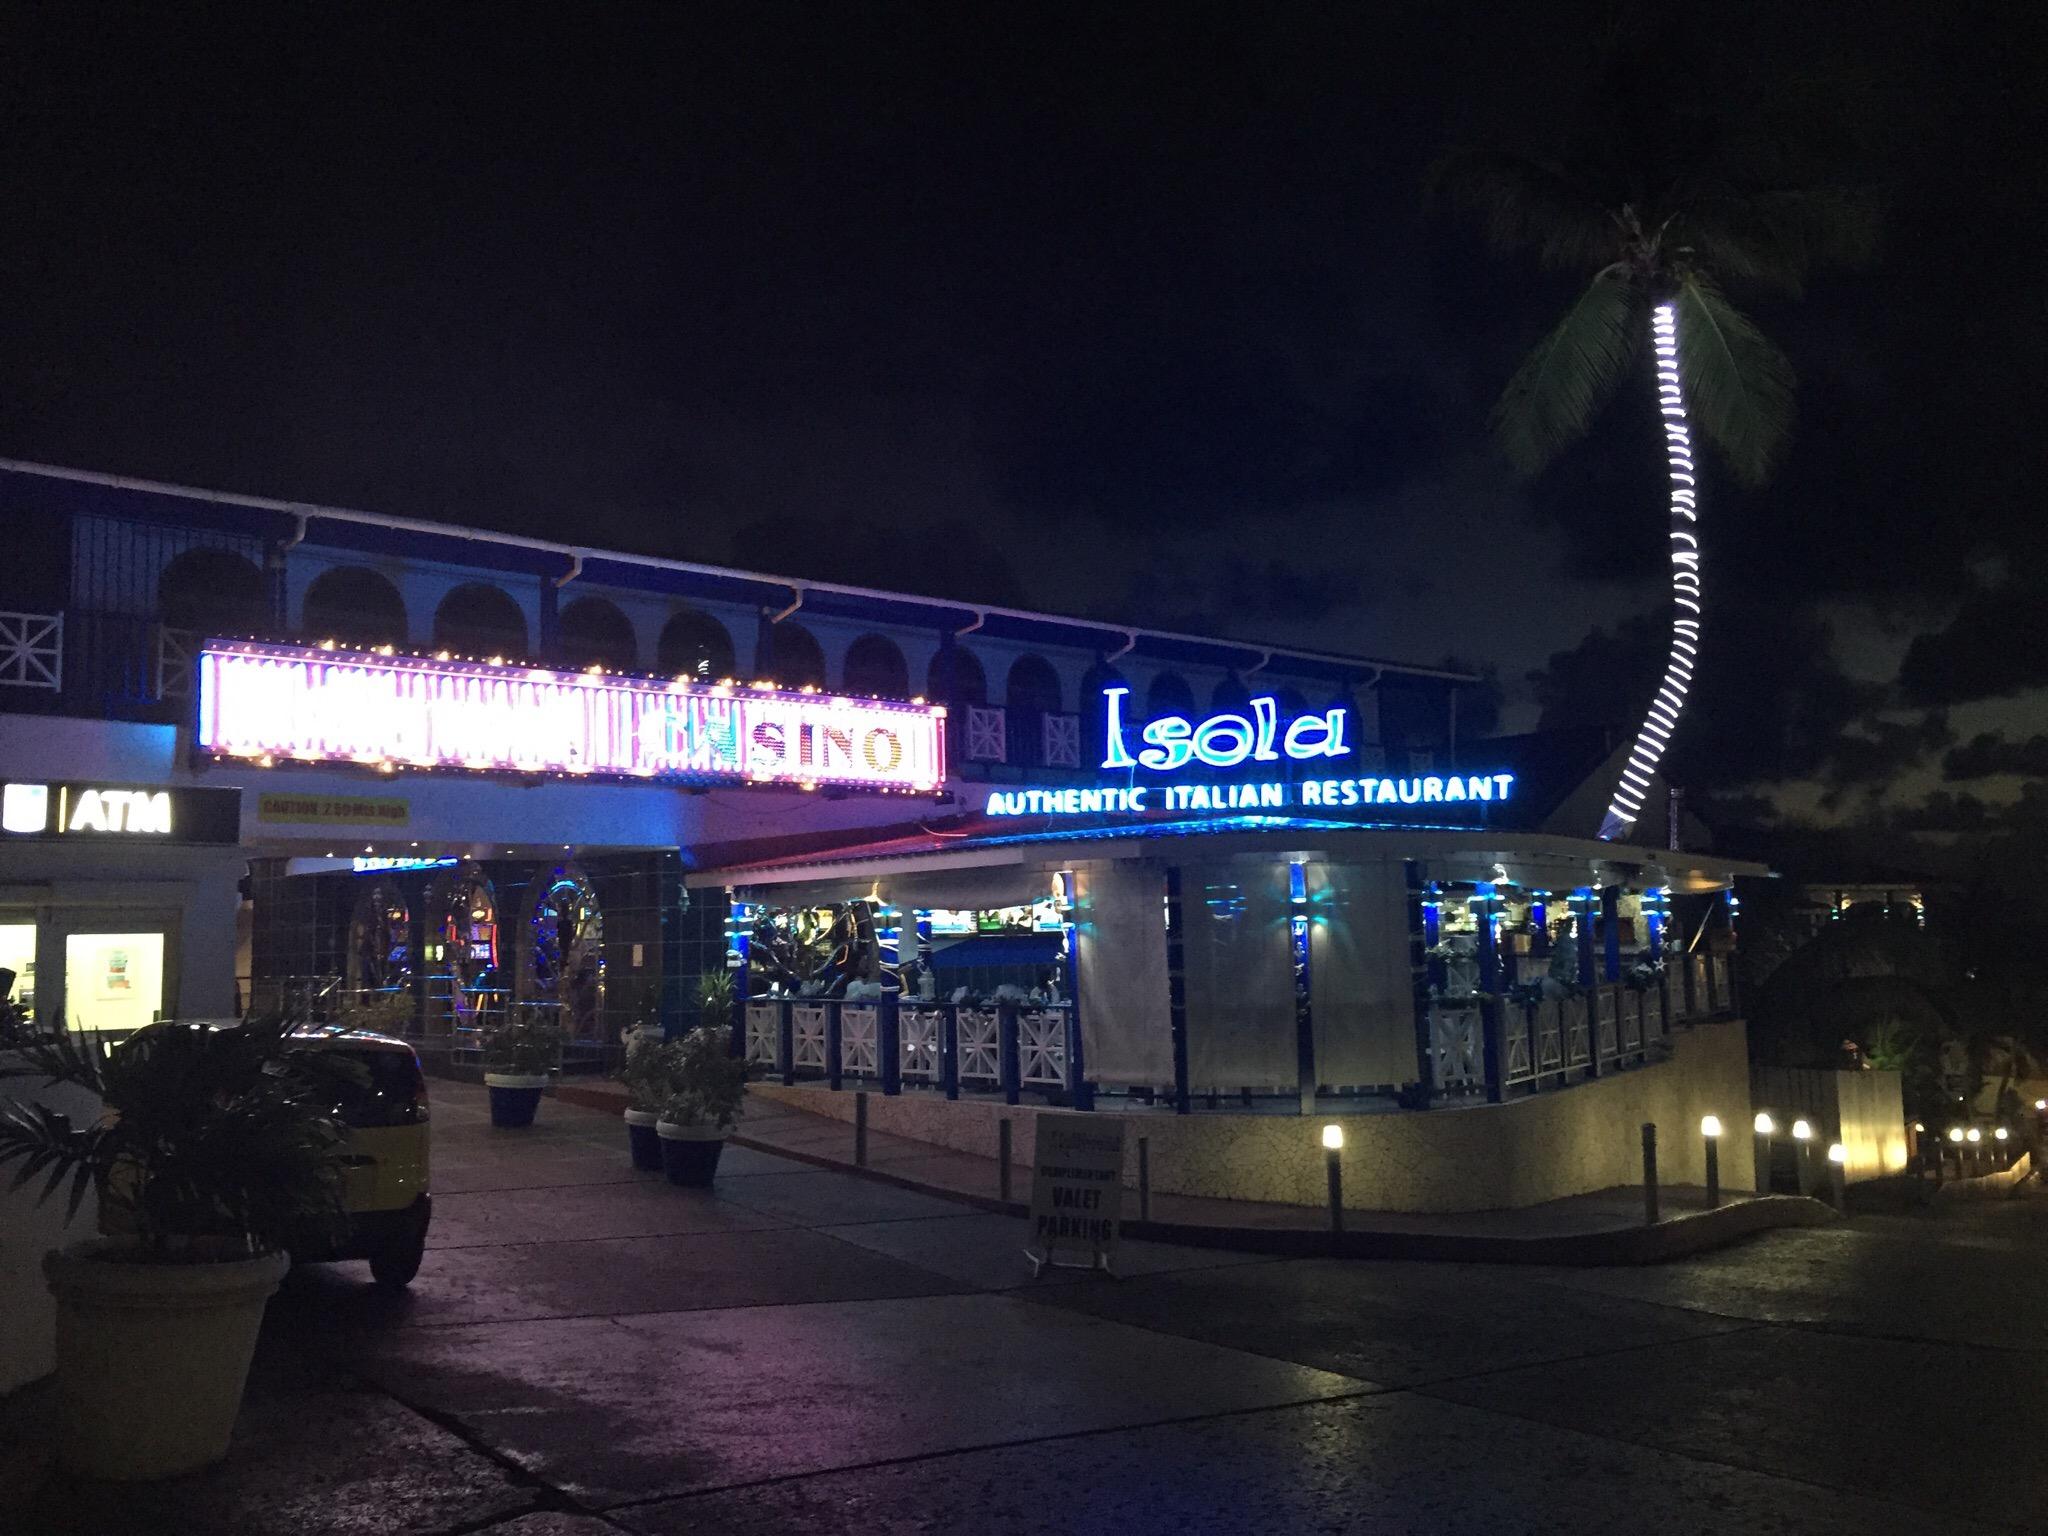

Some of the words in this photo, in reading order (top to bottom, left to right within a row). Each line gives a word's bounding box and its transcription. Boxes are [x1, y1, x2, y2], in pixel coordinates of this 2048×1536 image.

[1101, 687, 1351, 771] Isola
[69, 790, 172, 833] ATM
[263, 799, 318, 815] CAUTION
[986, 785, 1147, 816] AUTHENTIC
[1165, 783, 1283, 810] ITALIAN
[1302, 774, 1514, 806] RESTAURANT
[1052, 1186, 1102, 1210] VALET
[1037, 1214, 1113, 1241] PARKING
